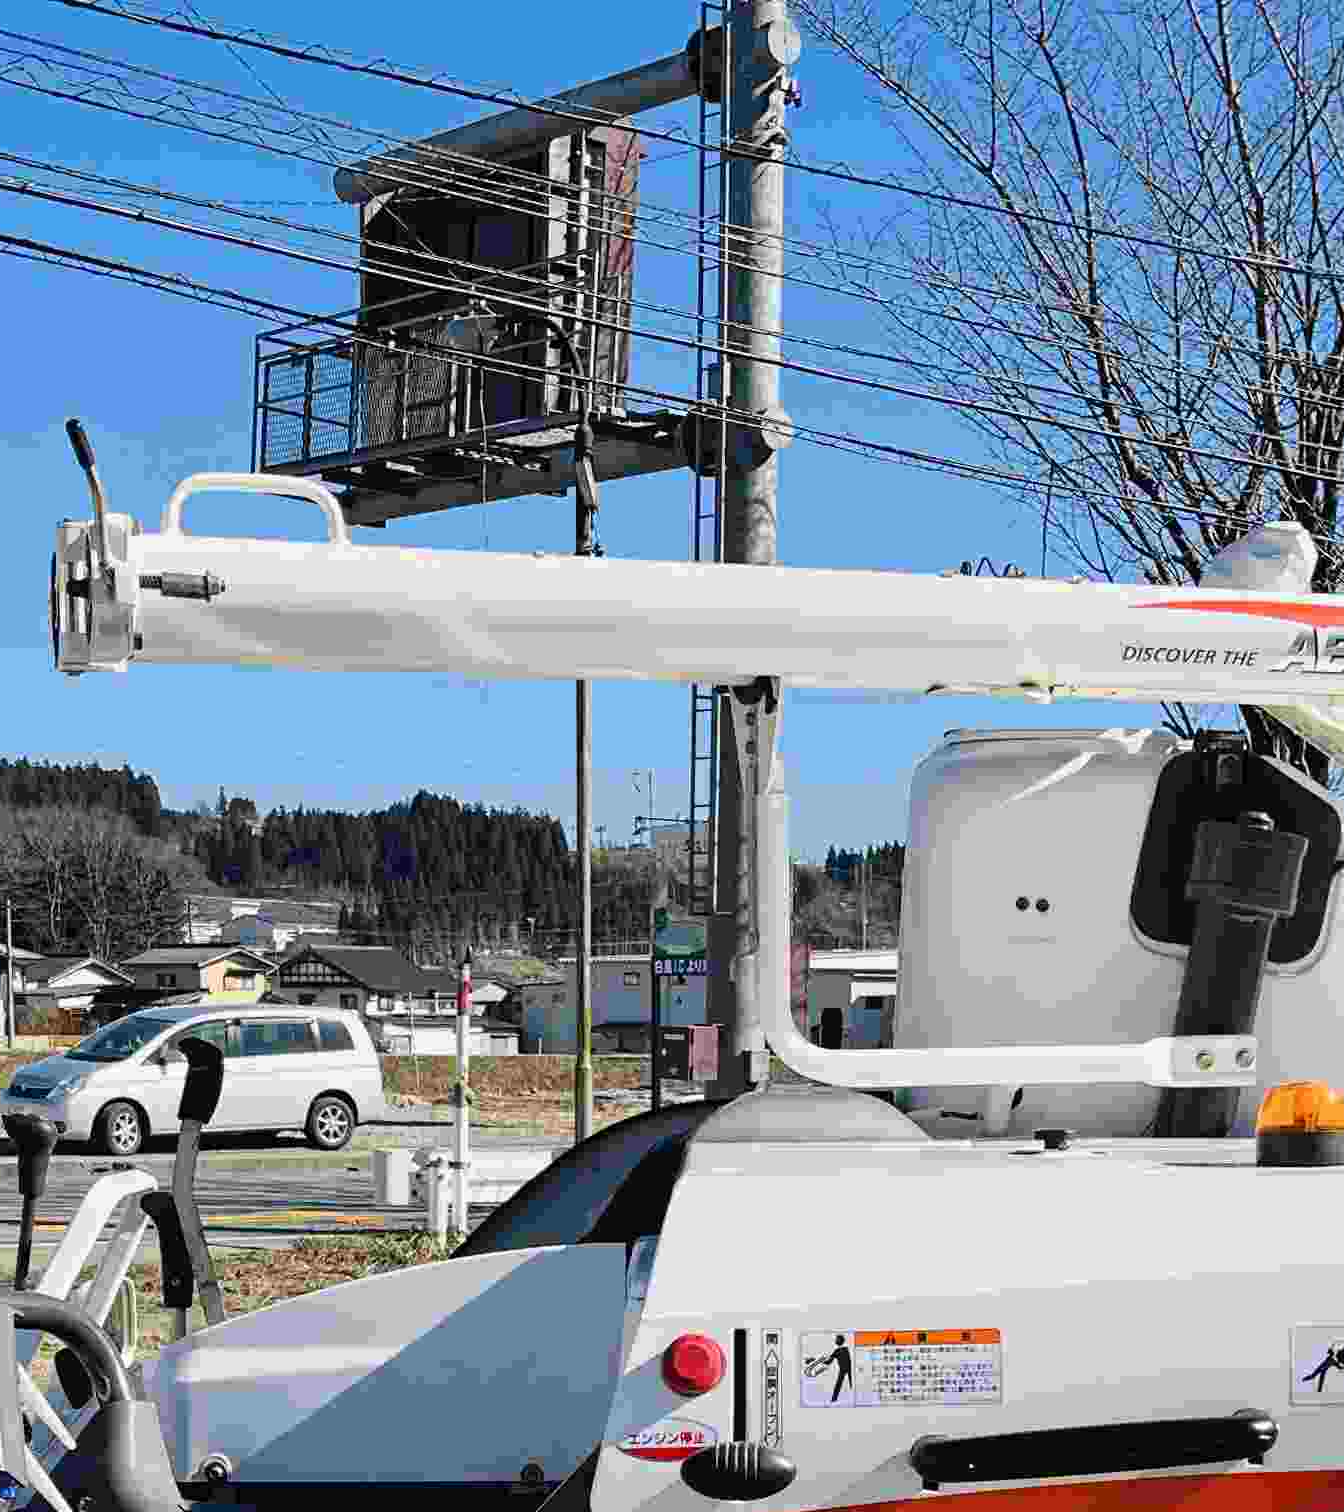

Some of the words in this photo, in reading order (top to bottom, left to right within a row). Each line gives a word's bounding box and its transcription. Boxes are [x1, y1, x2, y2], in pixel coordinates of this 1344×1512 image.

[1121, 645, 1217, 665] DISCOVER
[1223, 648, 1260, 667] THE
[625, 1431, 705, 1446] エンジン停止
